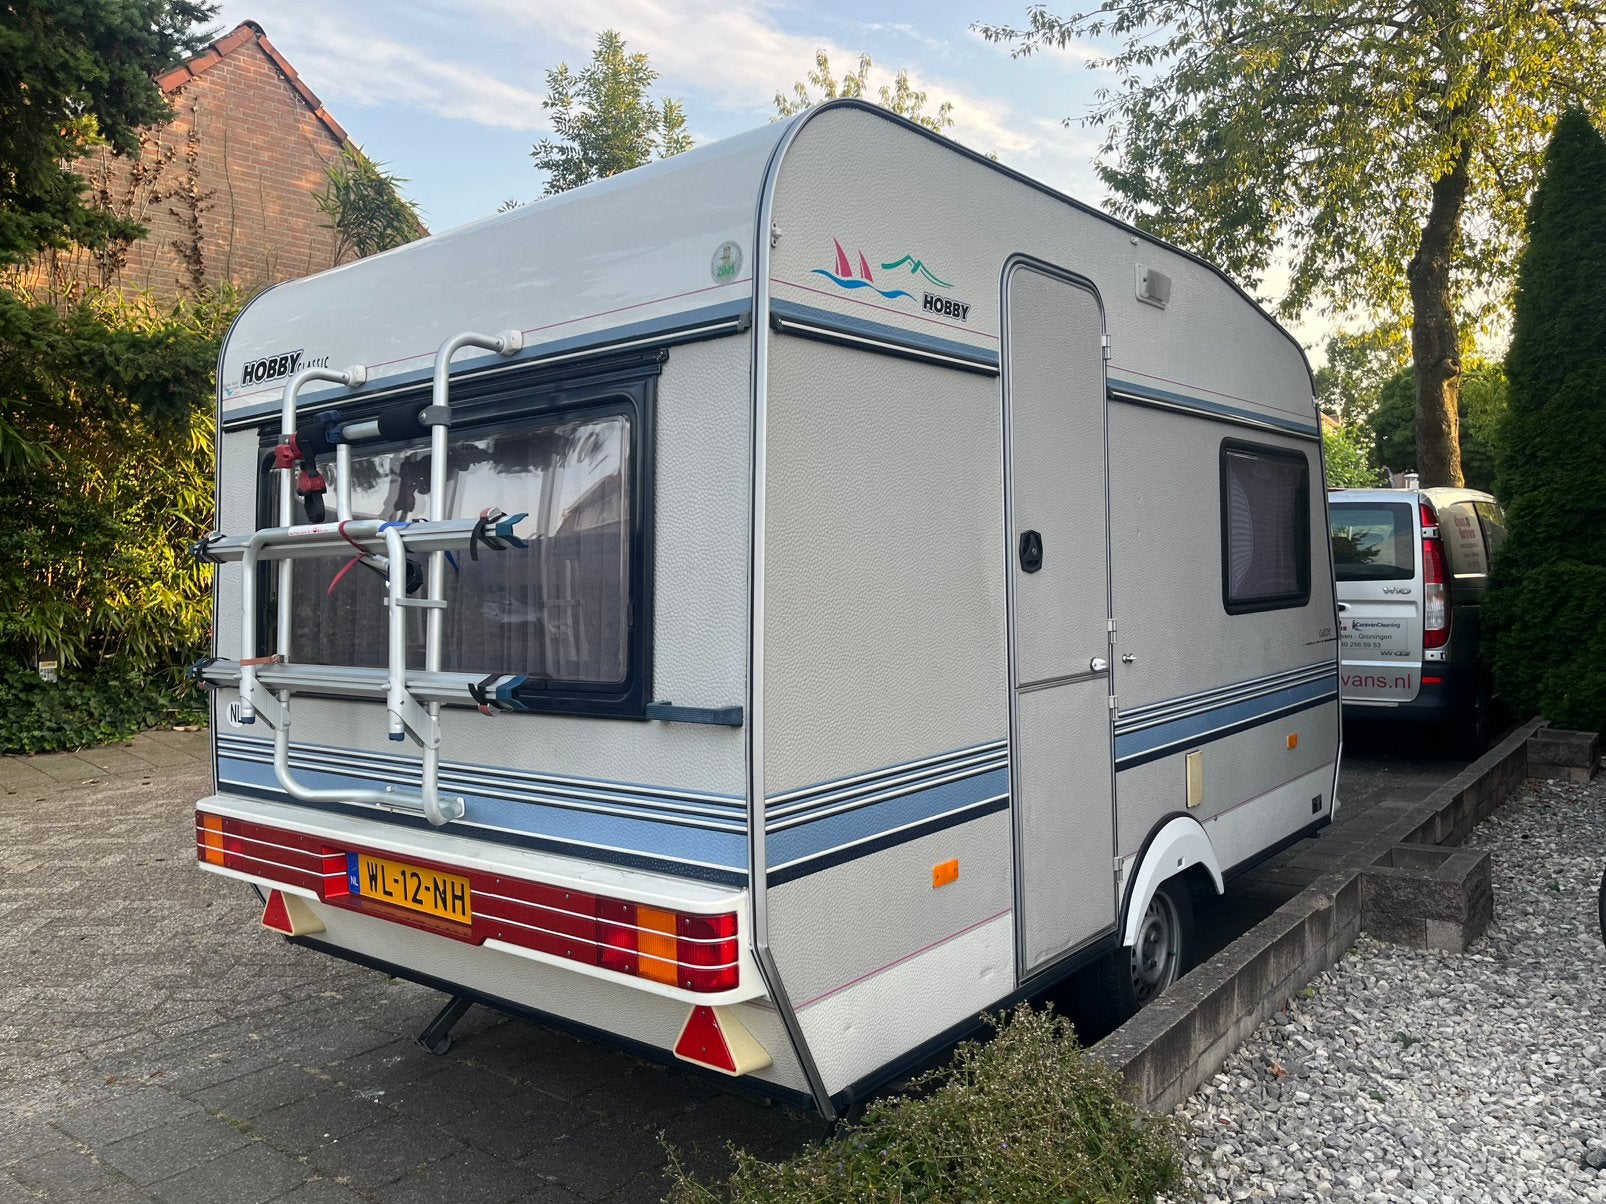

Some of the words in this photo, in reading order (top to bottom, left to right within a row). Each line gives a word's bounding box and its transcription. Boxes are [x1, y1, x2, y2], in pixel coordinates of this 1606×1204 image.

[923, 293, 970, 321] HOBBY
[242, 350, 303, 386] HOBBY
[1341, 674, 1412, 689] vans.nl
[350, 875, 359, 887] NL
[366, 861, 466, 917] WL-12-NH
